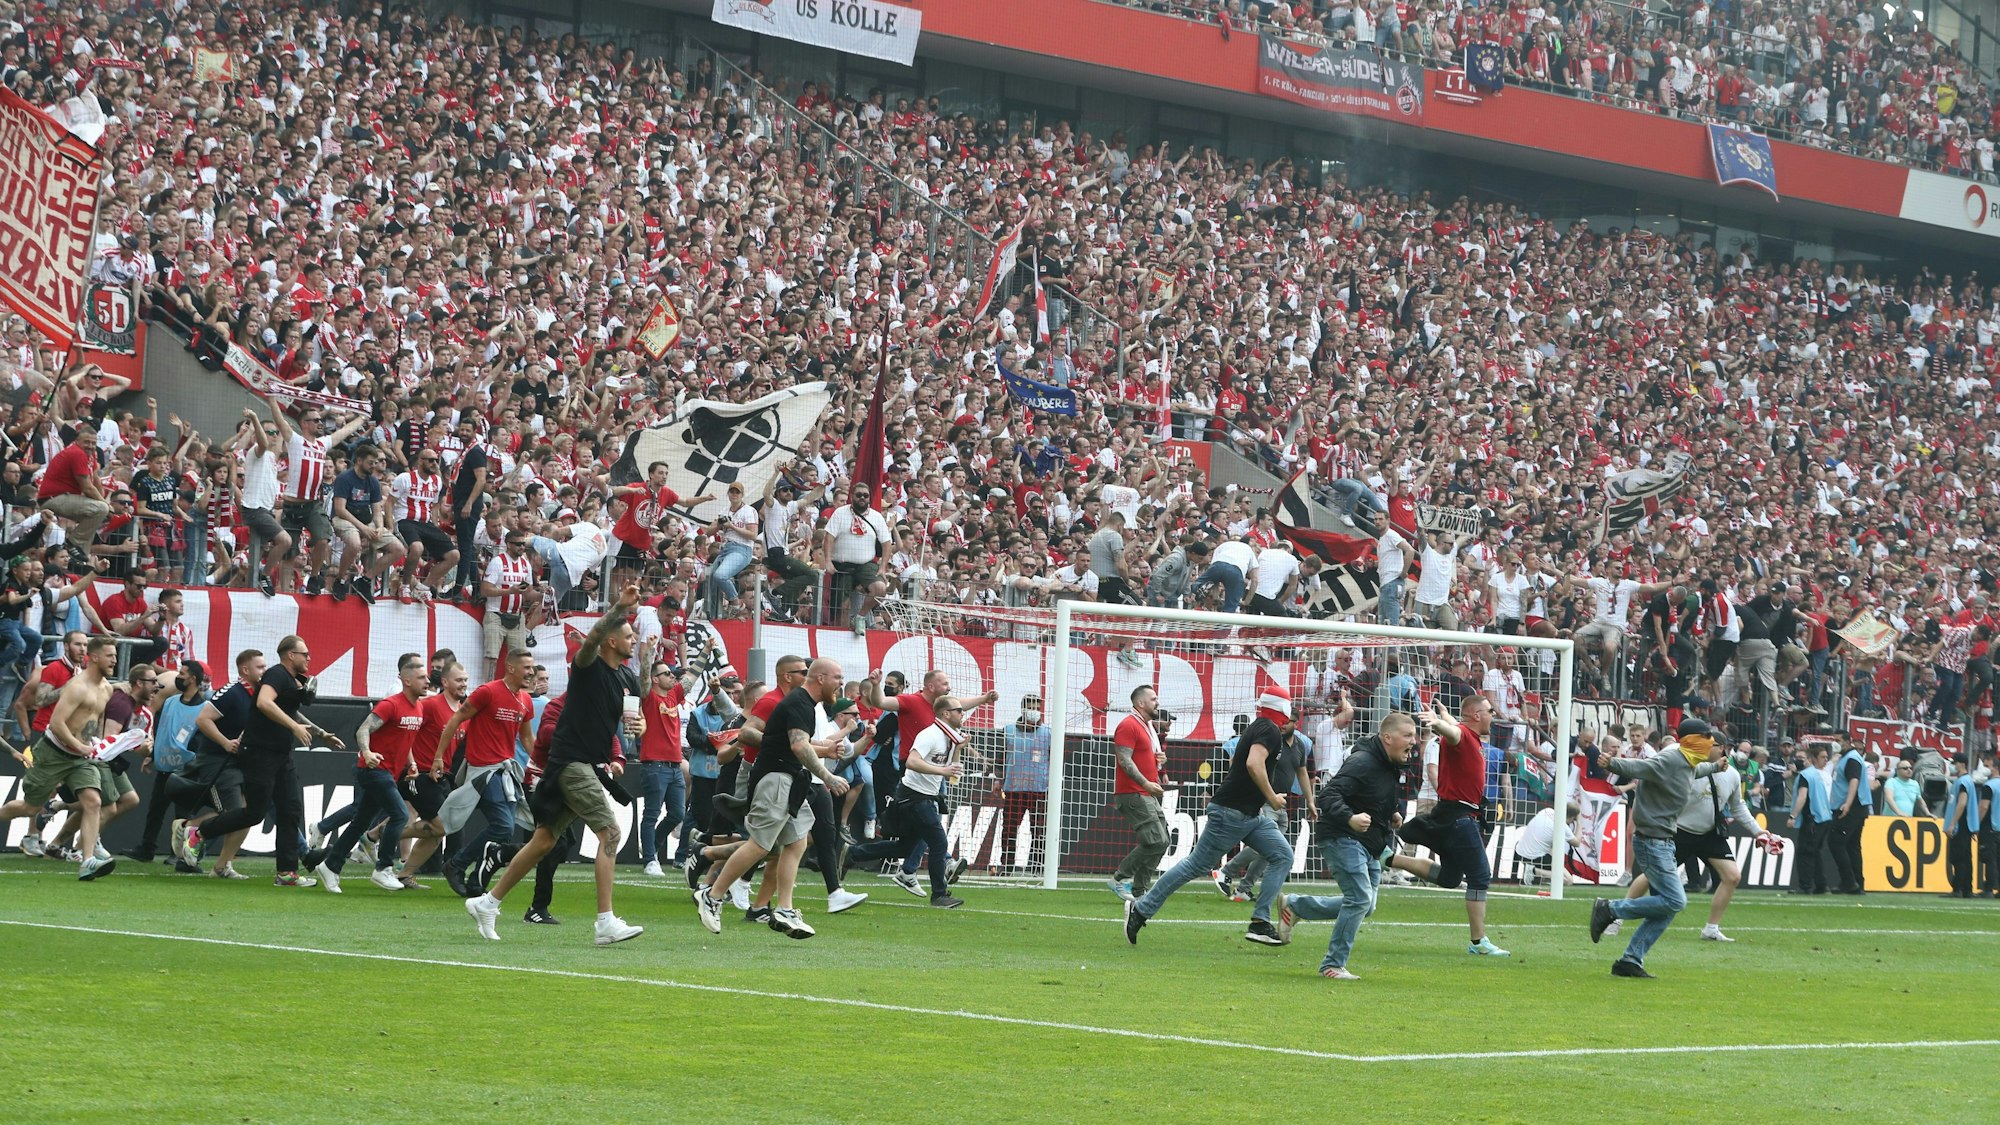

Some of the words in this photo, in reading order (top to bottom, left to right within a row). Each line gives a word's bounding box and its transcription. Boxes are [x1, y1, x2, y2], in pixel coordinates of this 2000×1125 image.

[1273, 78, 1280, 88] FC
[1990, 202, 2000, 220] R
[1850, 719, 1963, 759] FREAKS
[1600, 868, 1619, 878] SLIGA
